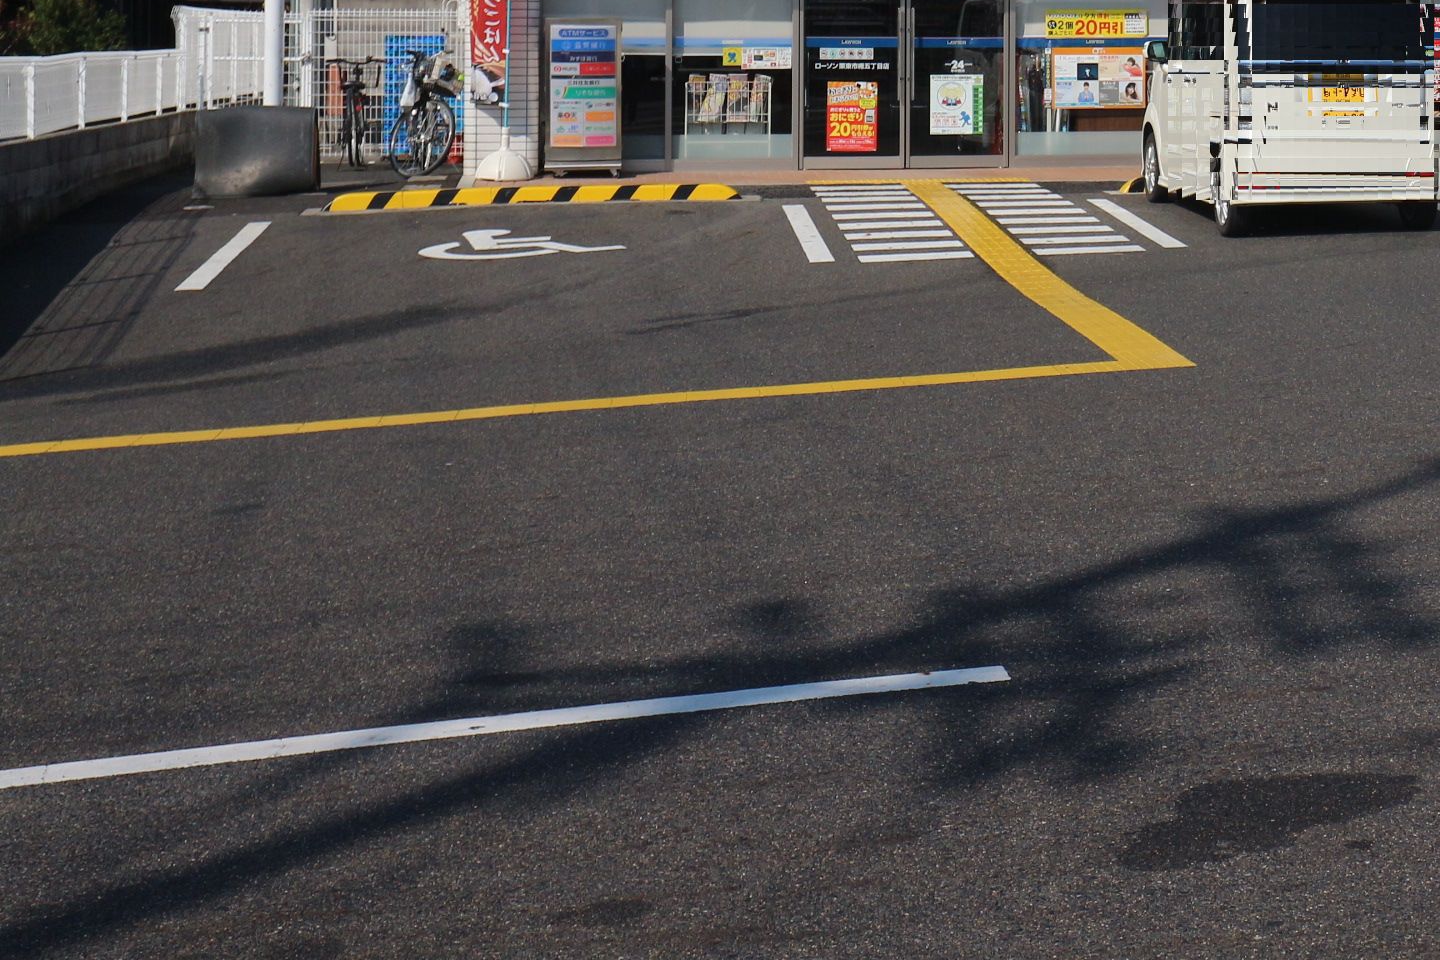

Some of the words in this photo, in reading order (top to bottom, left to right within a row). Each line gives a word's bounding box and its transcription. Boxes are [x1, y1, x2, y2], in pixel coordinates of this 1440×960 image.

[1075, 19, 1124, 35] 20円引
[950, 60, 965, 69] 24
[829, 112, 863, 122] おにぎり
